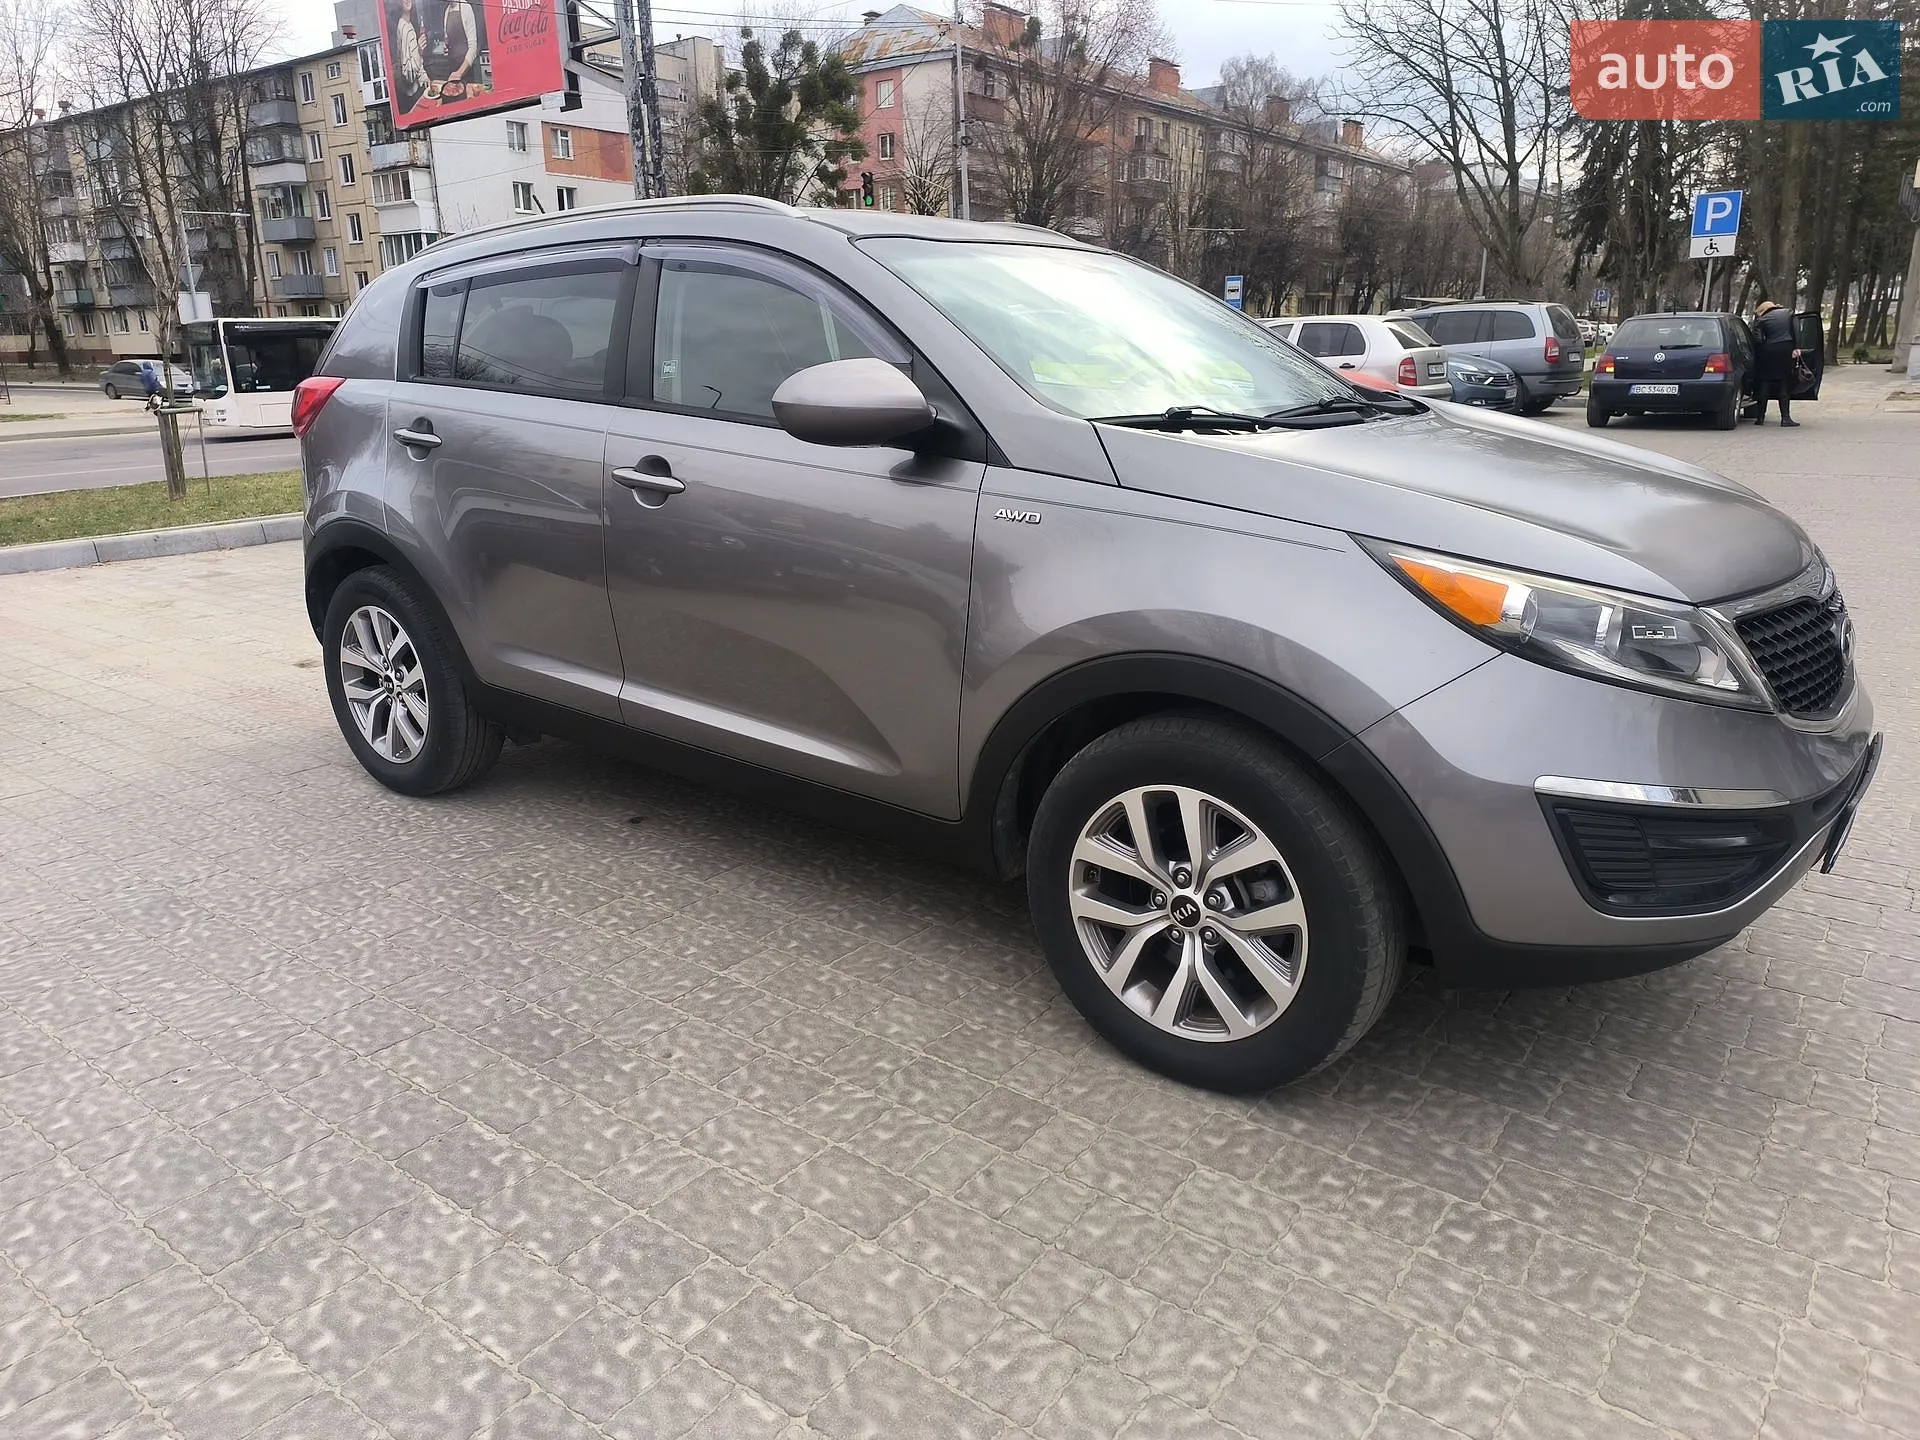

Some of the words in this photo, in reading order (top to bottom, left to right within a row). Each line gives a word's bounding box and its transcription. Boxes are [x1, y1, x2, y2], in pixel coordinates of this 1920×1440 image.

[1705, 197, 1732, 230] P
[994, 508, 1041, 524] AWD
[1173, 903, 1197, 921] KIA
